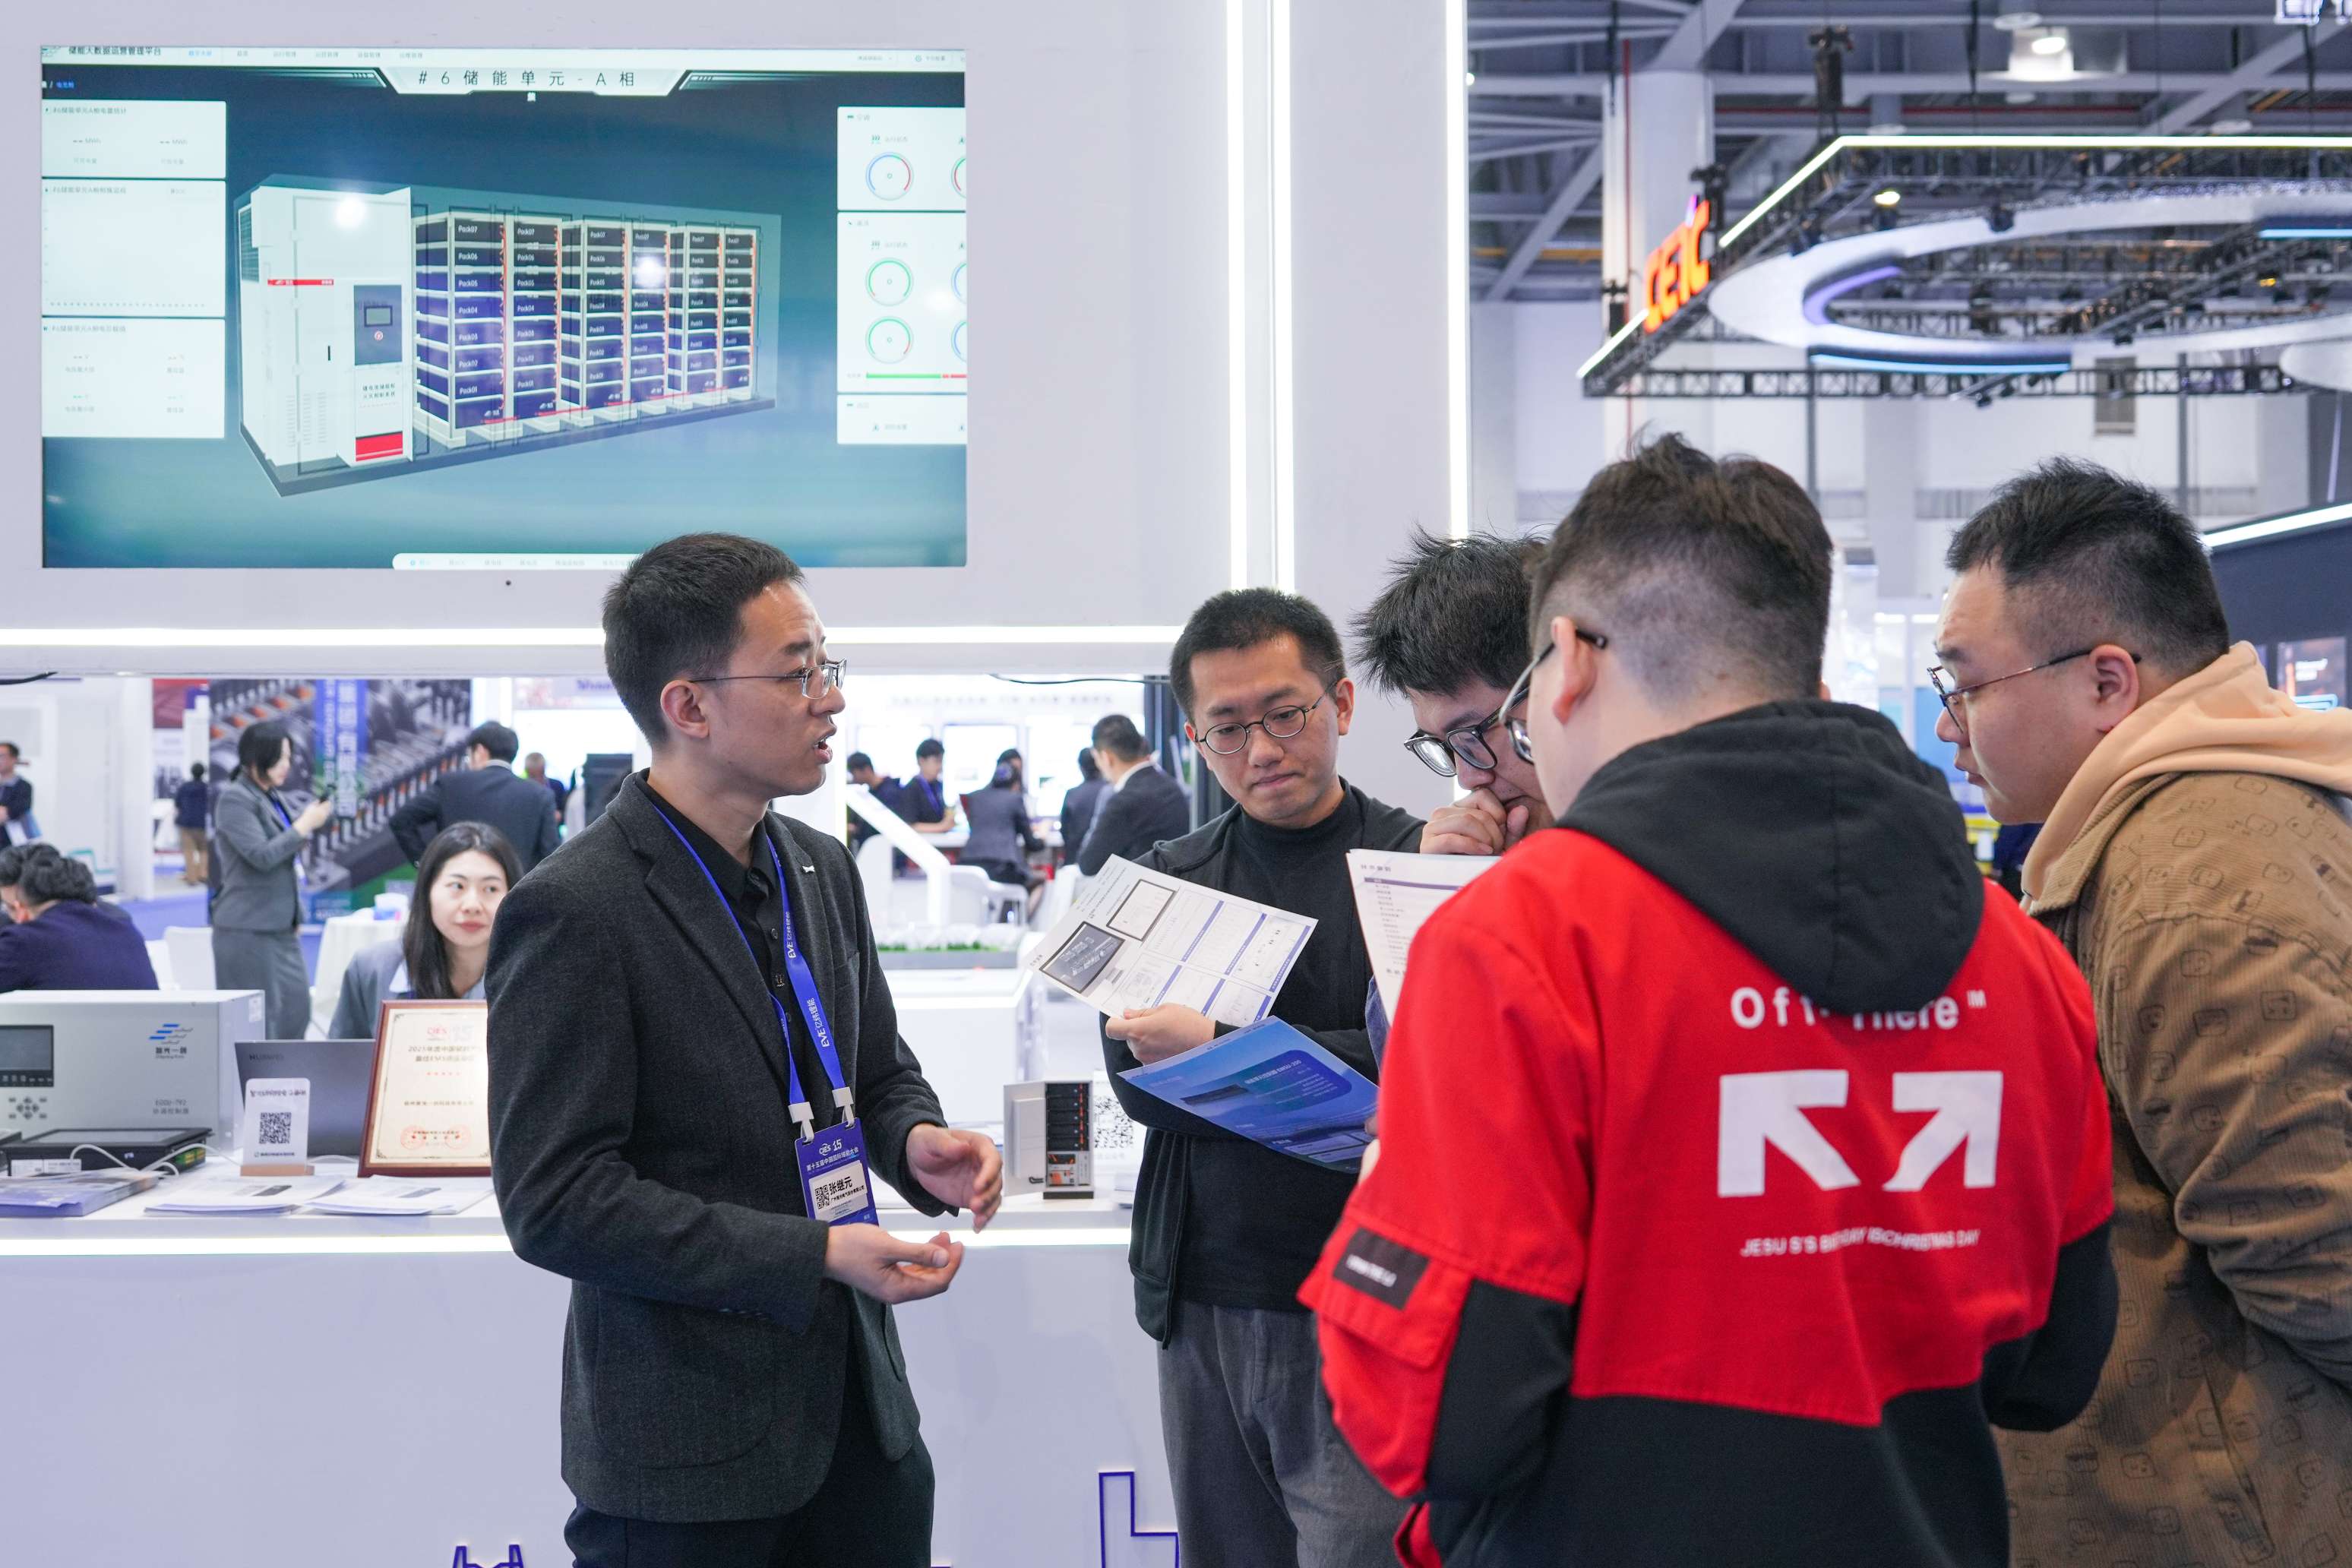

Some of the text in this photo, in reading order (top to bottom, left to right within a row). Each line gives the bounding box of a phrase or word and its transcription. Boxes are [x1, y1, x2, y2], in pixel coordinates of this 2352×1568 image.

[458, 225, 478, 233] Pack07
[786, 940, 796, 959] EVE
[807, 997, 830, 1048] EVE 亿纬锂能
[819, 1139, 842, 1155] CIES 15
[828, 1176, 853, 1196] 张继元
